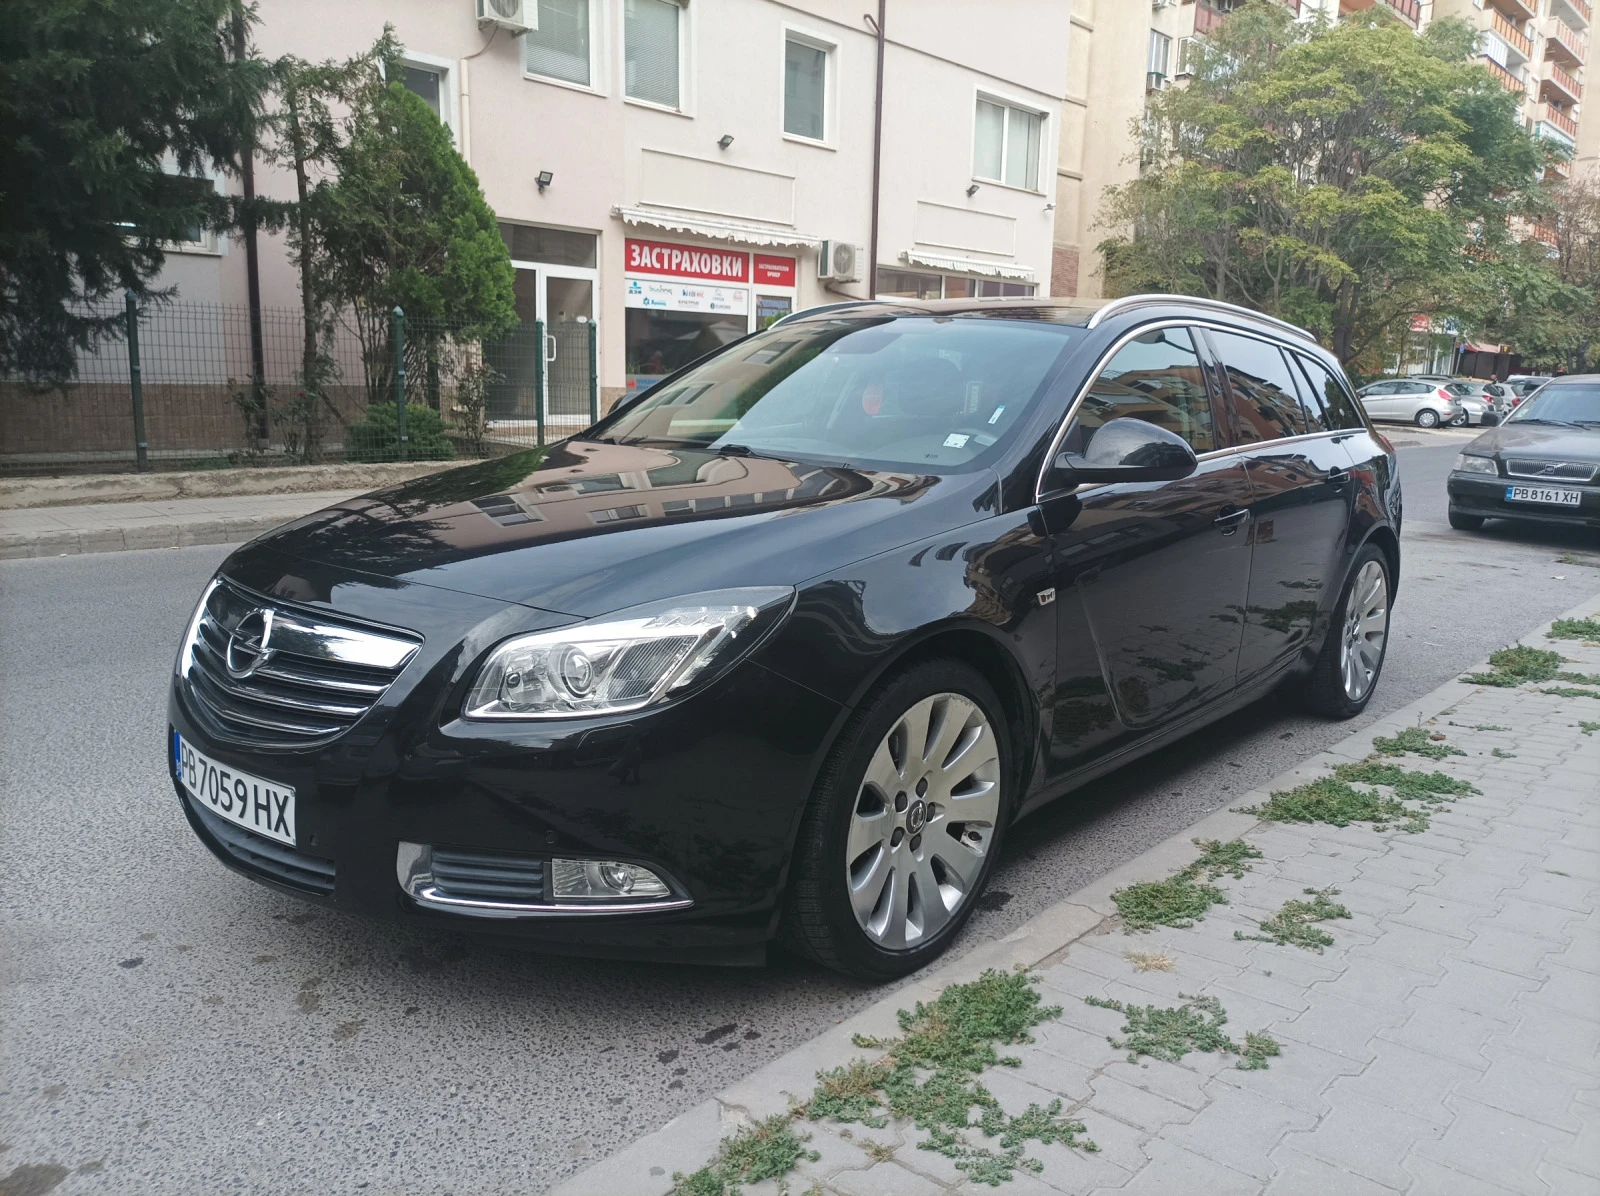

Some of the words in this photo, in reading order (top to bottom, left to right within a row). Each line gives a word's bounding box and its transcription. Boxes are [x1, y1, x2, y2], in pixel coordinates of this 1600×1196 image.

[630, 244, 742, 277] ЗАСТРАХОВКИ
[1530, 489, 1559, 502] 8161
[198, 757, 247, 819] 7059
